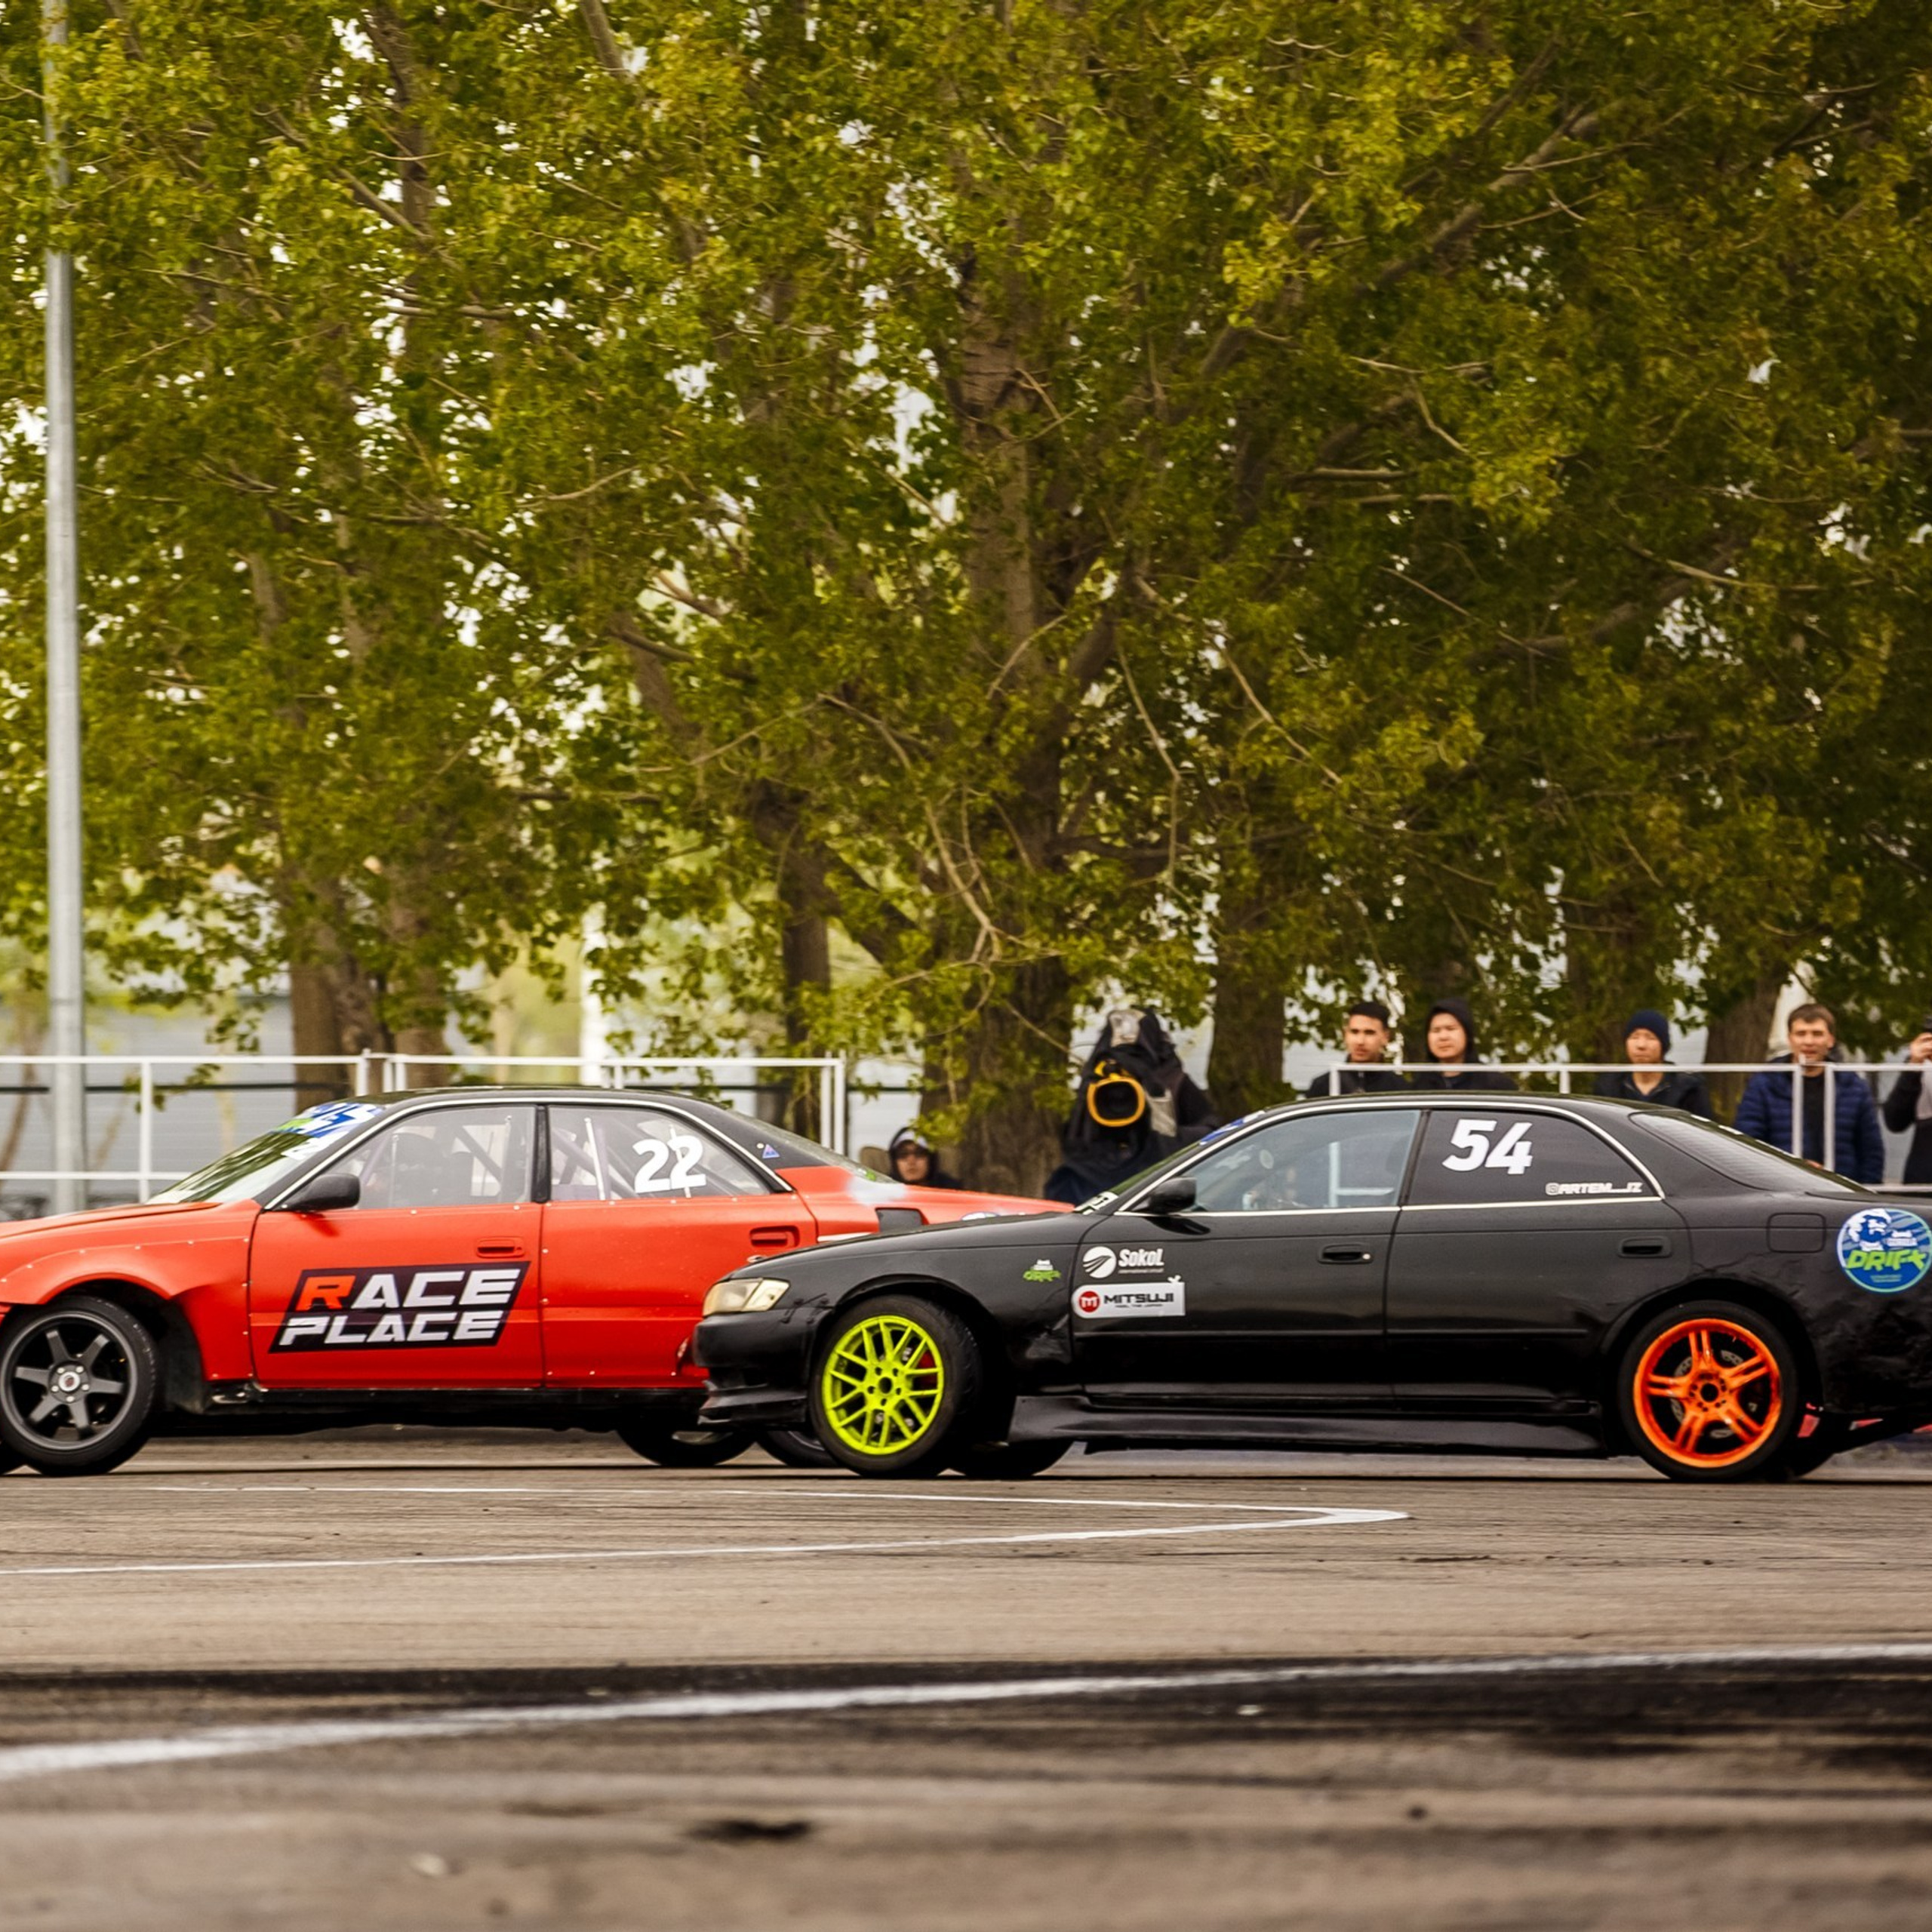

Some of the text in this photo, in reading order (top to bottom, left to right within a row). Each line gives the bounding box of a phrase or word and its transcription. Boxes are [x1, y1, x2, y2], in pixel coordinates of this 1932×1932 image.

[632, 1135, 706, 1193] 22
[1441, 1118, 1533, 1174] 54
[295, 1269, 521, 1311] RACE
[1104, 1293, 1174, 1303] MITSUJI
[279, 1310, 503, 1346] PLACE
